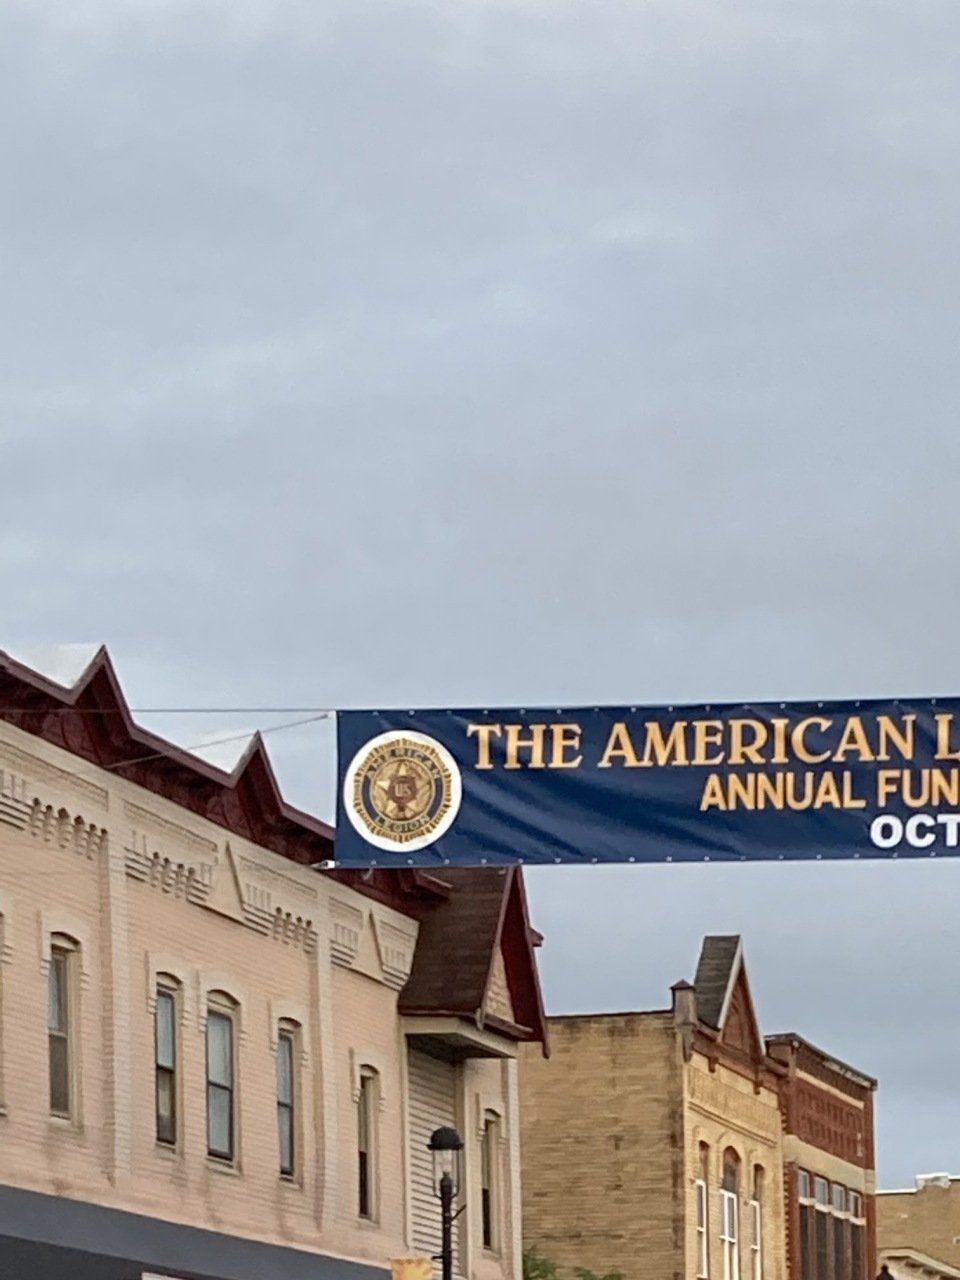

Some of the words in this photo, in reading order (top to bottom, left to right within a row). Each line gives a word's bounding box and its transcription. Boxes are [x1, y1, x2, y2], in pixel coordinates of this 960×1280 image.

[467, 724, 583, 770] THE
[597, 715, 917, 768] AMERICAN
[364, 747, 442, 780] AMERICAN
[700, 770, 867, 811] ANNUAL
[374, 813, 431, 833] LEGION
